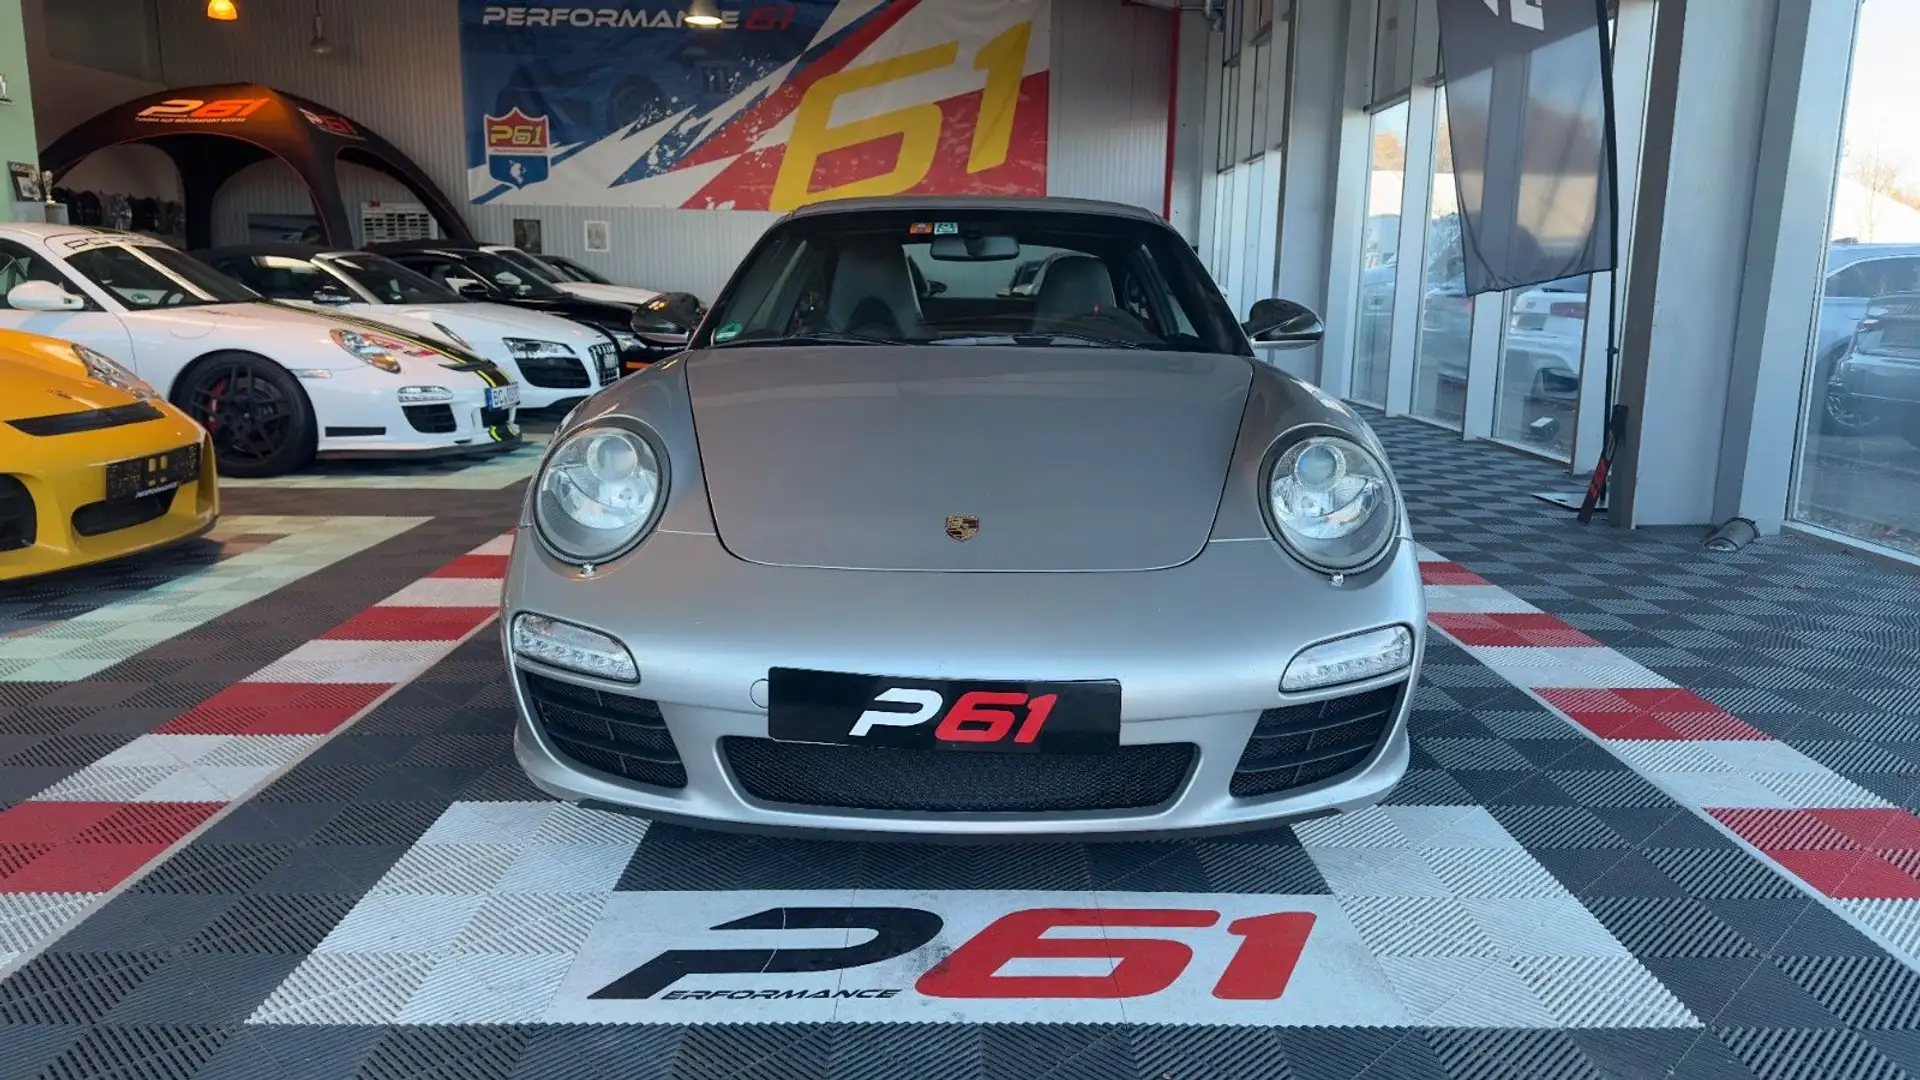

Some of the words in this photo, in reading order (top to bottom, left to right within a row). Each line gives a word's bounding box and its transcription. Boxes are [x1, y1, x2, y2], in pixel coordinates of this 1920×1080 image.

[482, 6, 740, 29] PERFORMANE
[744, 5, 797, 30] 61
[136, 98, 270, 117] P61
[768, 21, 1033, 213] 61
[490, 125, 544, 145] P61
[848, 687, 1058, 743] P61
[586, 906, 1318, 1000] P61
